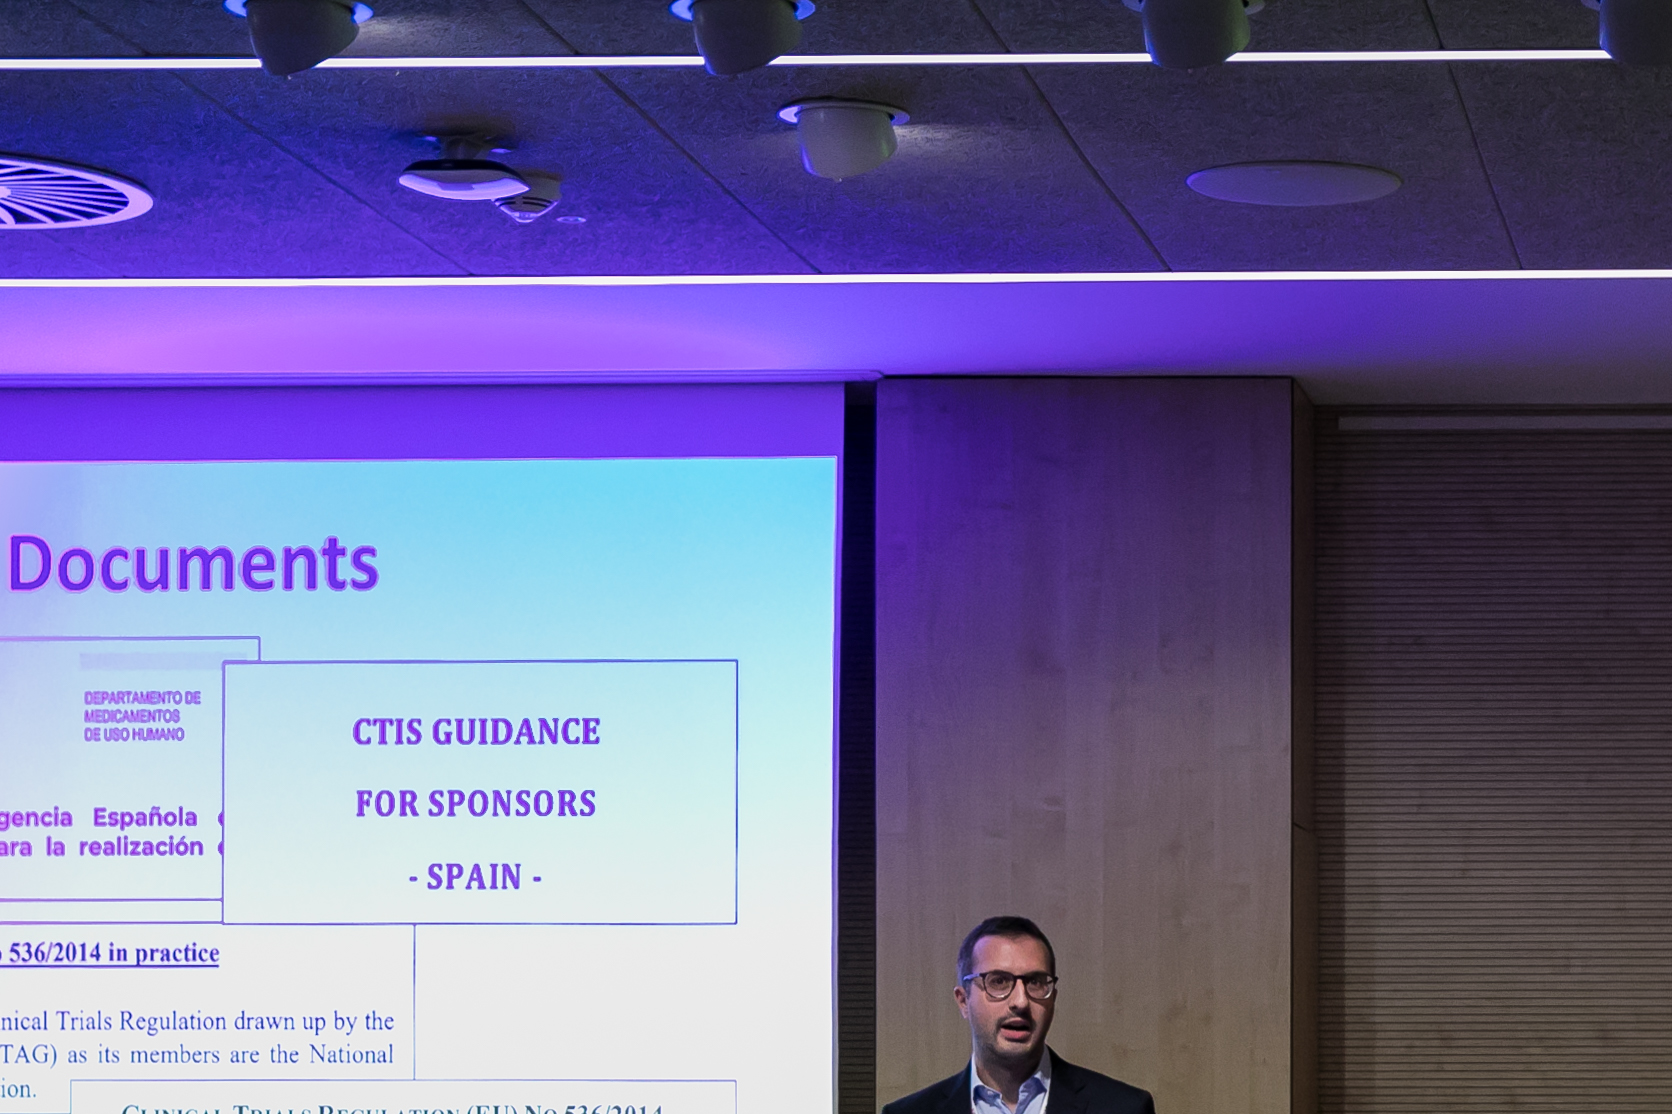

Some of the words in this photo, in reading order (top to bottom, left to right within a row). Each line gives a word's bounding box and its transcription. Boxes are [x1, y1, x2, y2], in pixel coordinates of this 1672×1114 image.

[9, 535, 379, 592] Documents
[84, 690, 183, 706] DEPARTAMENTO
[185, 690, 202, 706] DE
[84, 708, 181, 724] MEDICAMENTOS
[84, 726, 101, 742] DE
[103, 726, 130, 742] USO
[132, 726, 185, 742] HUMANO
[352, 717, 423, 746] CTIS
[432, 717, 601, 746] GUIDANCE
[356, 789, 419, 818] FOR
[427, 789, 597, 818] SPONSORS
[93, 805, 198, 832] Española
[46, 835, 66, 857] la
[79, 835, 204, 857] realización
[427, 862, 522, 891] SPAIN
[9, 941, 102, 962] 536/2014
[109, 941, 128, 962] in
[136, 941, 220, 965] practice
[1, 1010, 48, 1031] nical
[56, 1010, 113, 1031] Trials
[120, 1010, 227, 1036] Regulation
[235, 1010, 295, 1031] drawn
[303, 1016, 326, 1036] up
[334, 1010, 357, 1036] by
[365, 1010, 395, 1031] the
[0, 1043, 57, 1069] TAG)
[67, 1050, 88, 1064] as
[98, 1043, 120, 1064] its
[131, 1043, 220, 1064] members
[230, 1050, 260, 1064] are
[271, 1043, 299, 1064] the
[309, 1043, 394, 1064] National
[1, 1077, 37, 1098] ion.
